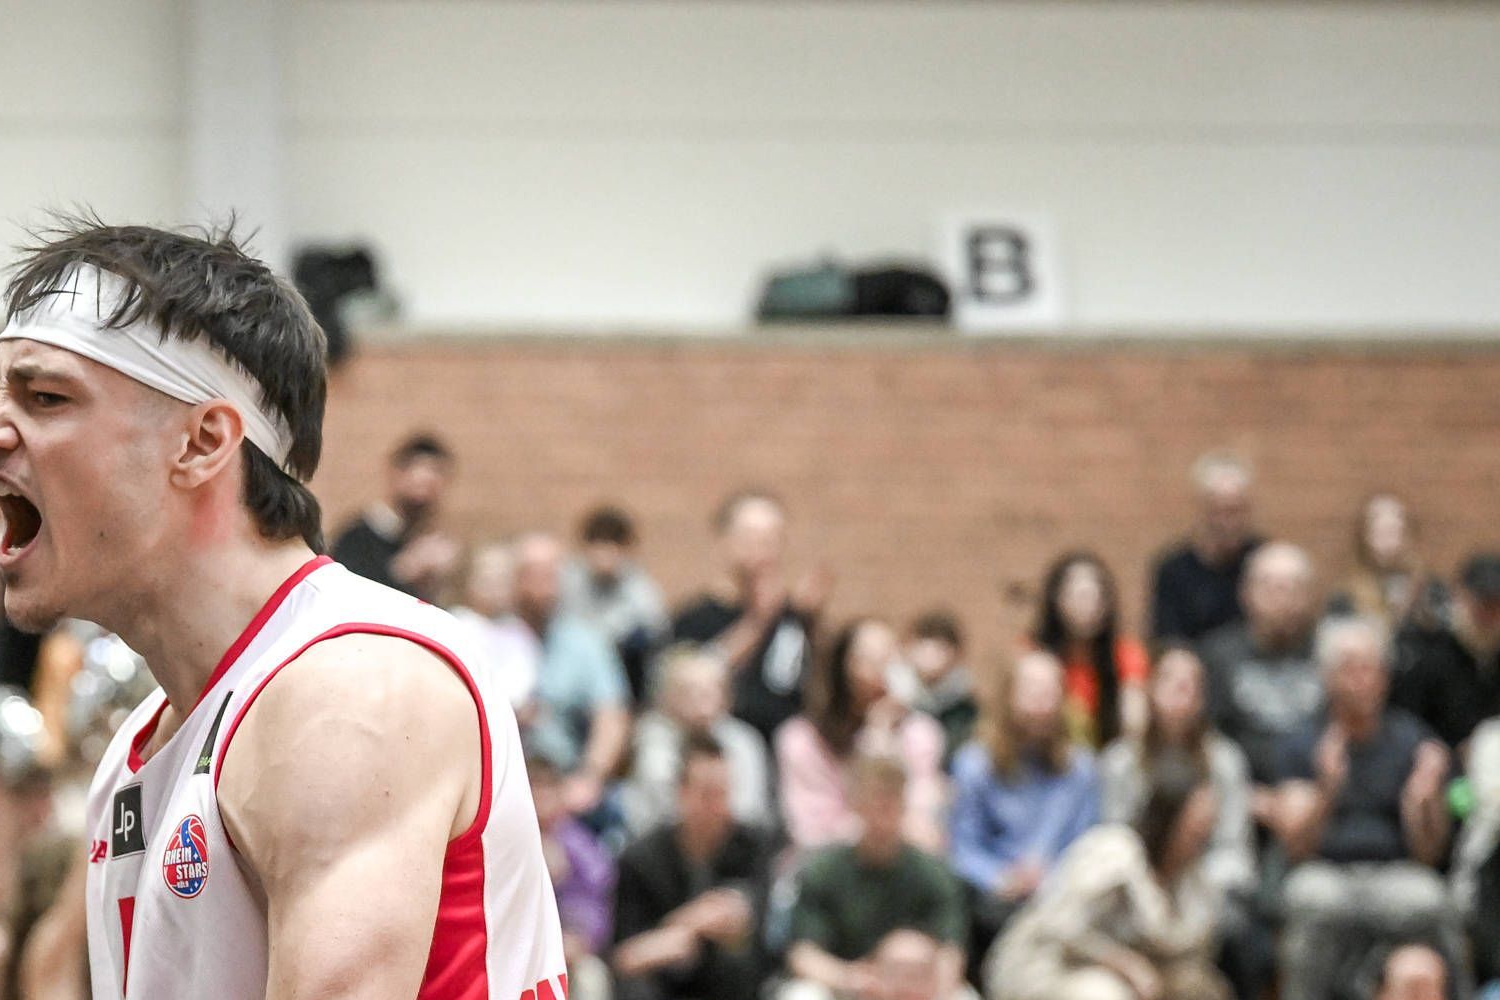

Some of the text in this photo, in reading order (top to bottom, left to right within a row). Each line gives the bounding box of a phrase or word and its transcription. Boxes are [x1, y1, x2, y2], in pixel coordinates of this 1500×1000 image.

[966, 225, 1033, 304] B
[164, 846, 192, 866] RHEIN
[176, 861, 208, 880] STARS
